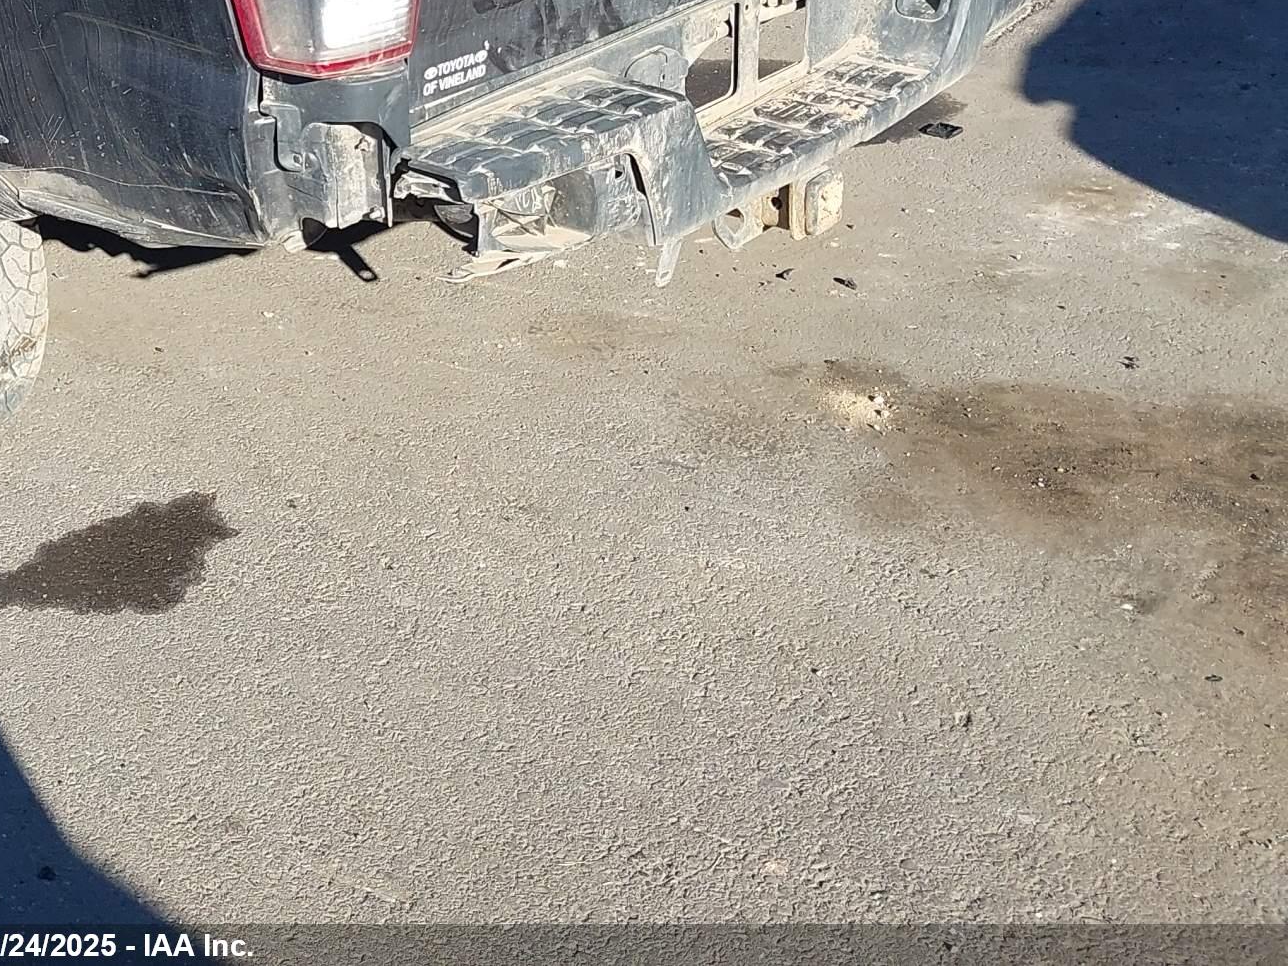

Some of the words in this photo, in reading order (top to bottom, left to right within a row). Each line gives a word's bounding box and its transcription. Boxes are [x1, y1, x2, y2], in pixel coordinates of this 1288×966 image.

[436, 53, 476, 76] TOYOTA
[422, 79, 439, 97] OF
[438, 64, 487, 91] VINELAND
